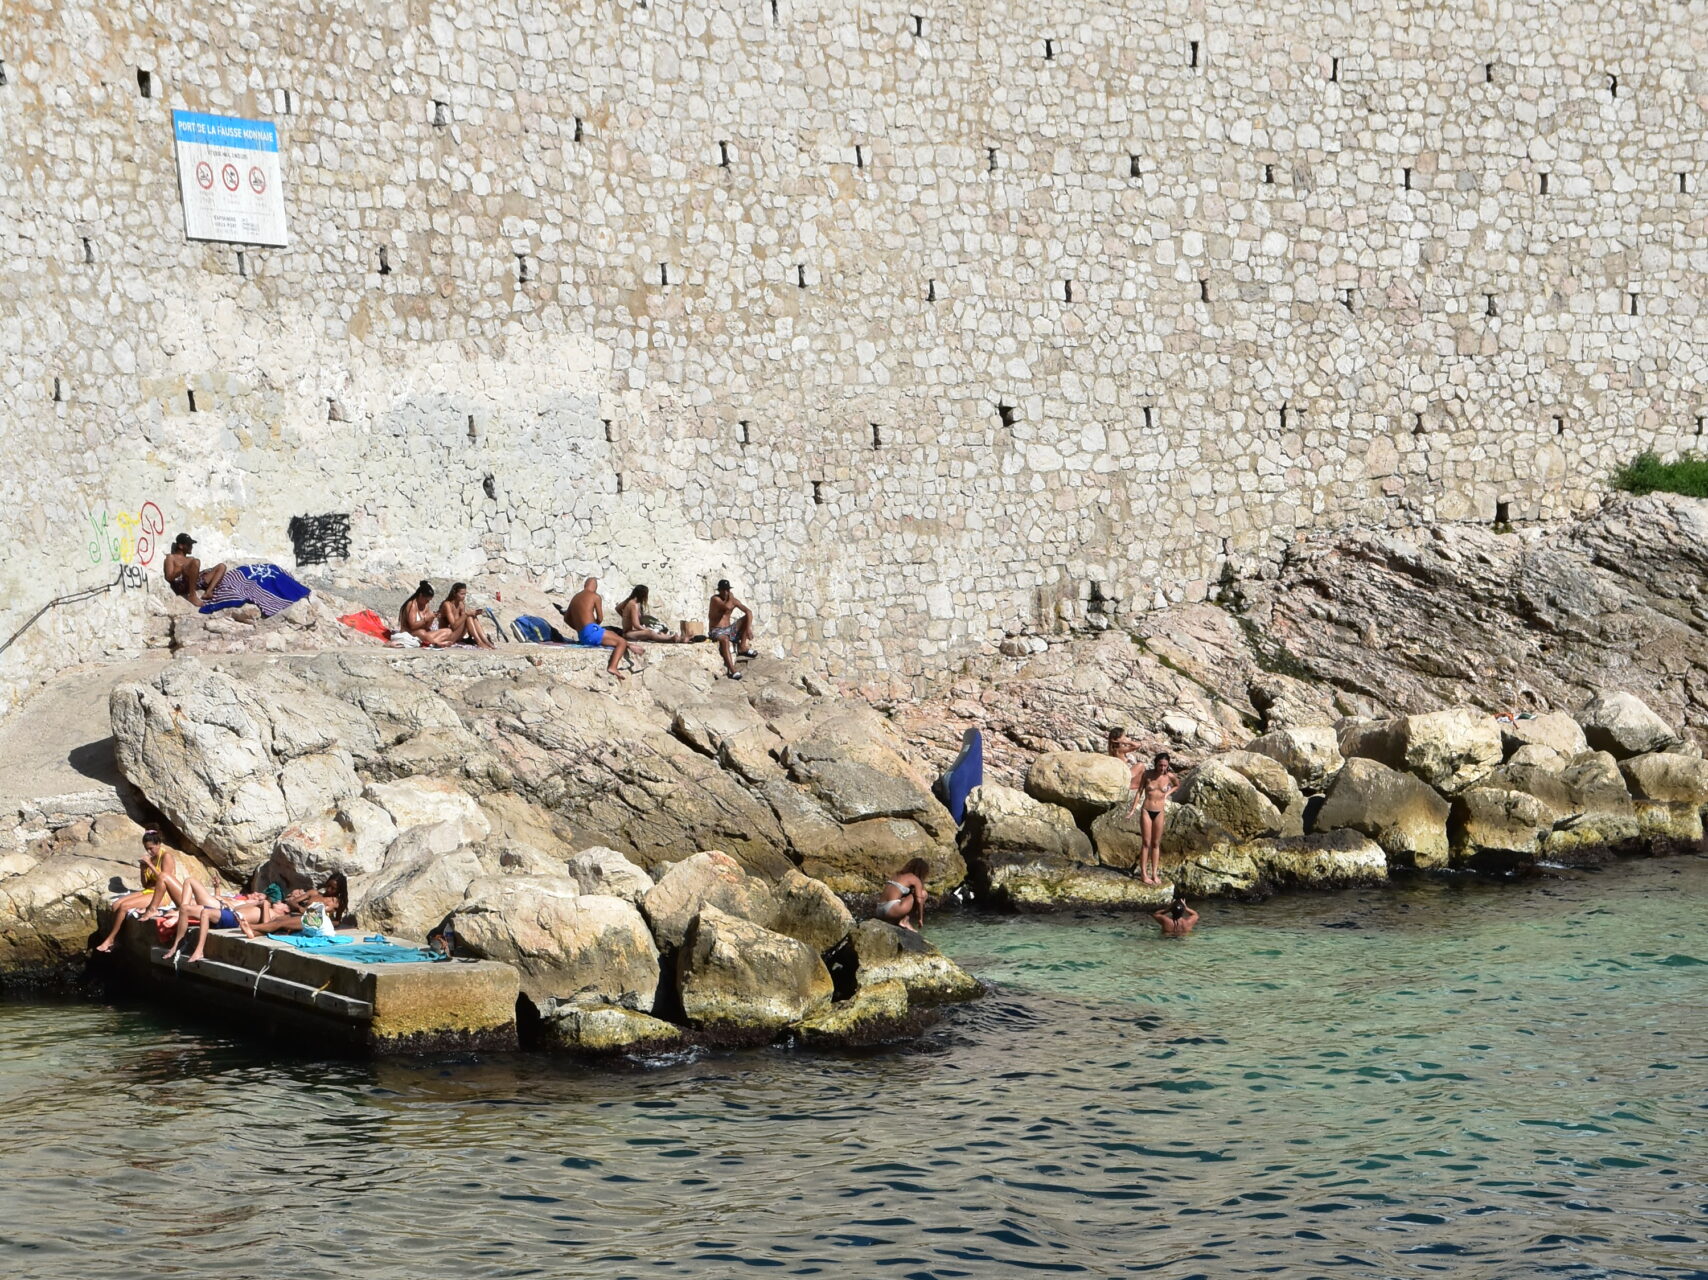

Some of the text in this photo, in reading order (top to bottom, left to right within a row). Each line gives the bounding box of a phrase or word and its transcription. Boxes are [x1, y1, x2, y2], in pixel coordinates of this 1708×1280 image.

[178, 120, 274, 142] PORT DE LA FAUSSE MONNAIE
[119, 563, 149, 593] 1994
